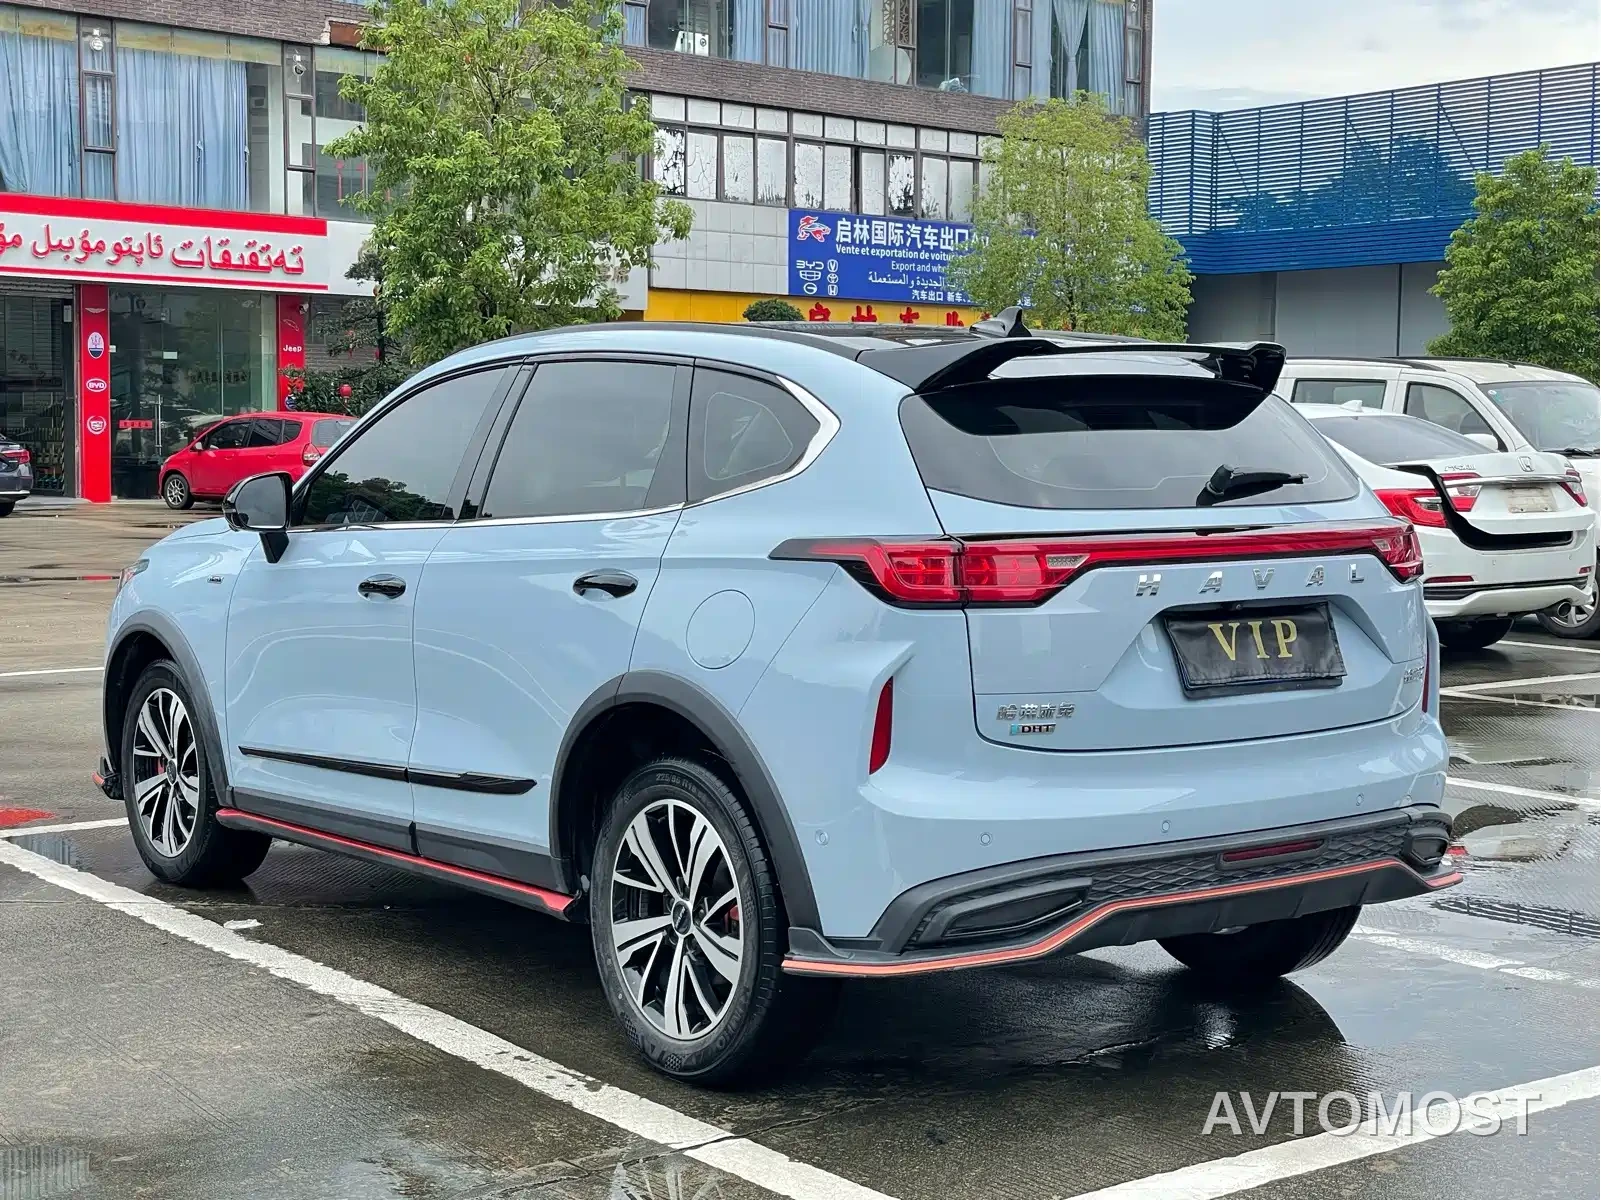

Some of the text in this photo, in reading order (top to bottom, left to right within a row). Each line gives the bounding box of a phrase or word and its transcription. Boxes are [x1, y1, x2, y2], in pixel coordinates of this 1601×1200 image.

[836, 218, 969, 252] 启林国际汽车出口
[836, 243, 860, 255] Vente
[861, 246, 870, 256] et
[871, 247, 919, 259] exportation
[920, 250, 930, 260] de
[891, 261, 915, 272] Export
[916, 263, 931, 273] and
[911, 289, 944, 301] 汽车出口
[1136, 564, 1365, 597] HAVAL
[1208, 619, 1298, 660] VIP
